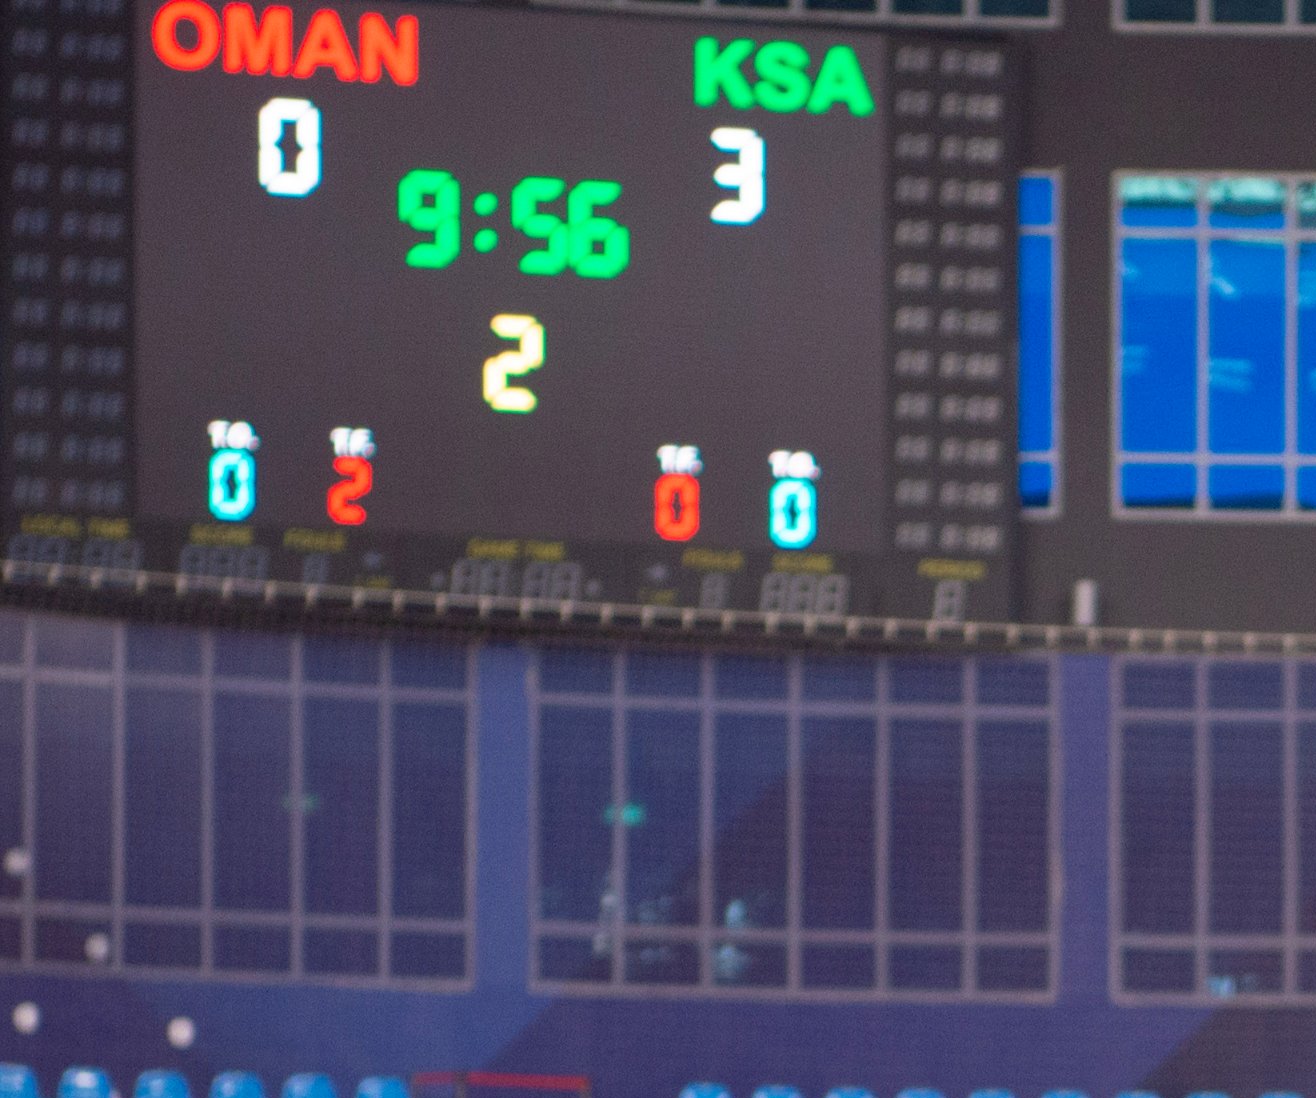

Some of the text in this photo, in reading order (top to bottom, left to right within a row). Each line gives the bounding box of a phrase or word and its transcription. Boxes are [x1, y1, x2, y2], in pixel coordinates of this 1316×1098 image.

[151, 0, 419, 87] OMAN
[694, 36, 875, 117] KSA
[258, 97, 321, 197] 0
[710, 127, 765, 225] 3
[398, 169, 630, 279] 9:56
[483, 313, 546, 413] 2
[208, 449, 257, 521] 0
[327, 456, 373, 526] 2
[654, 473, 701, 542] 0
[769, 478, 818, 549] 0
